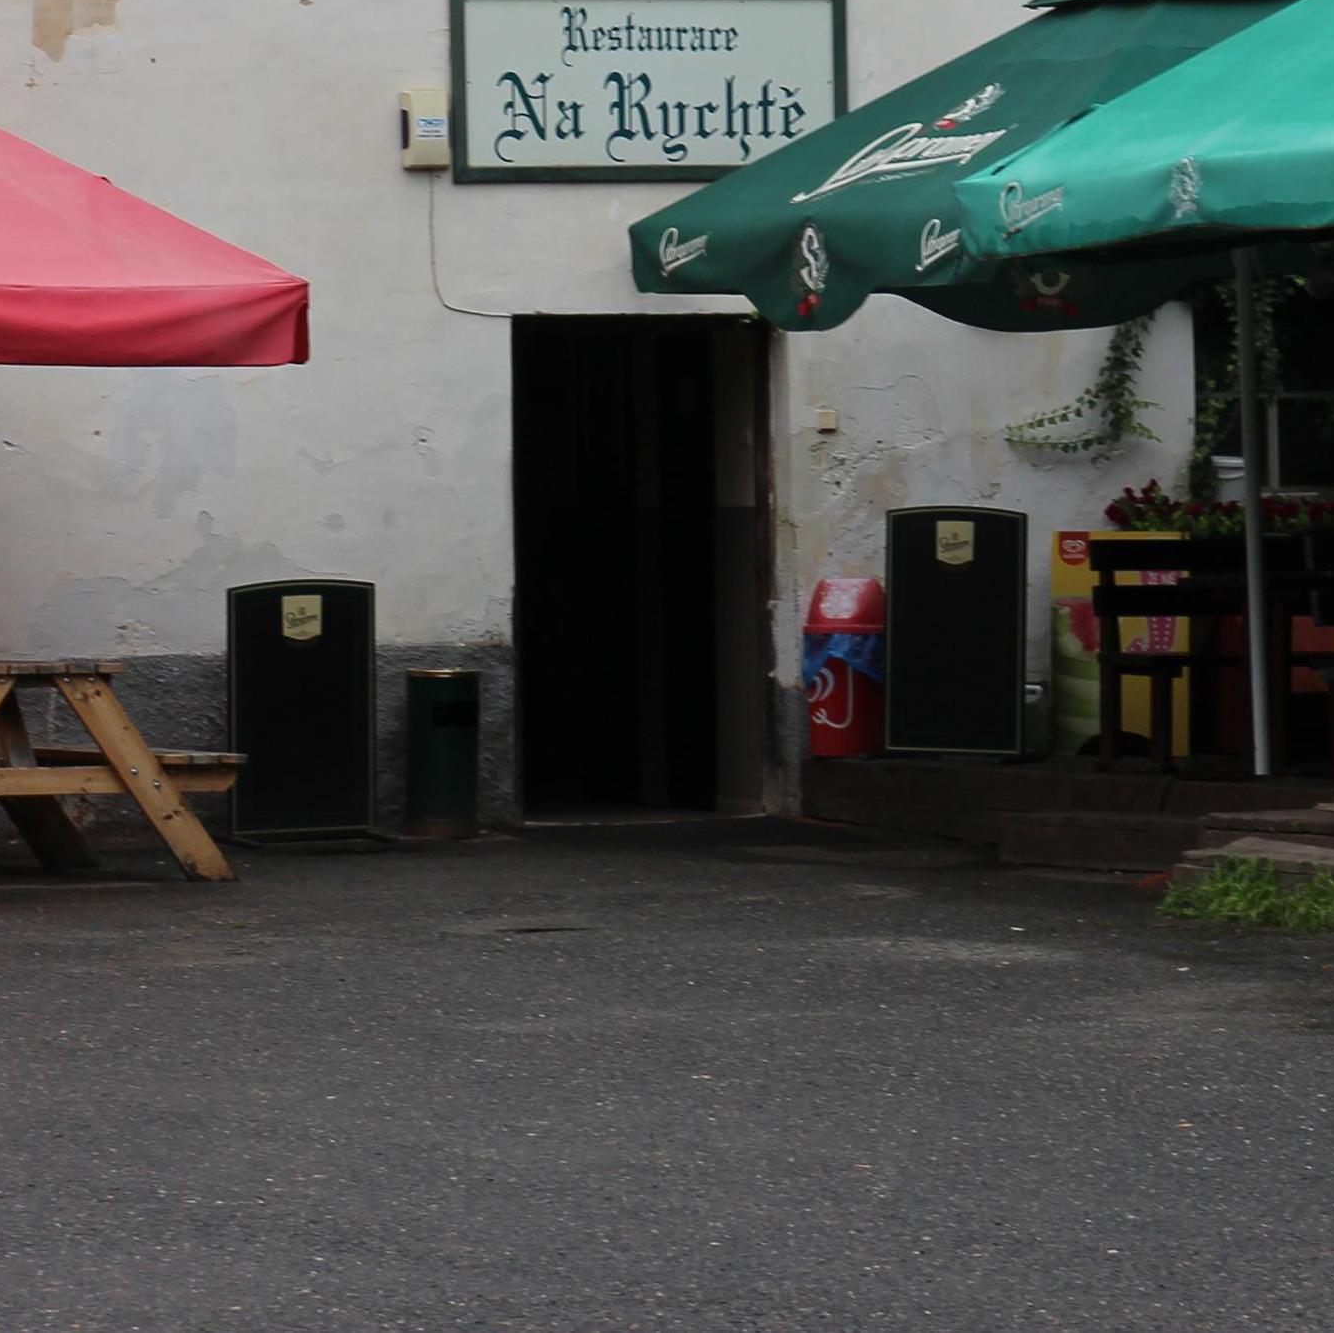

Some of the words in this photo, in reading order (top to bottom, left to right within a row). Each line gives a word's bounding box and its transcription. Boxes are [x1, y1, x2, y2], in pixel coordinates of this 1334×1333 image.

[560, 5, 740, 67] Restaurace
[493, 70, 585, 164] Na
[603, 70, 808, 164] Rychtě
